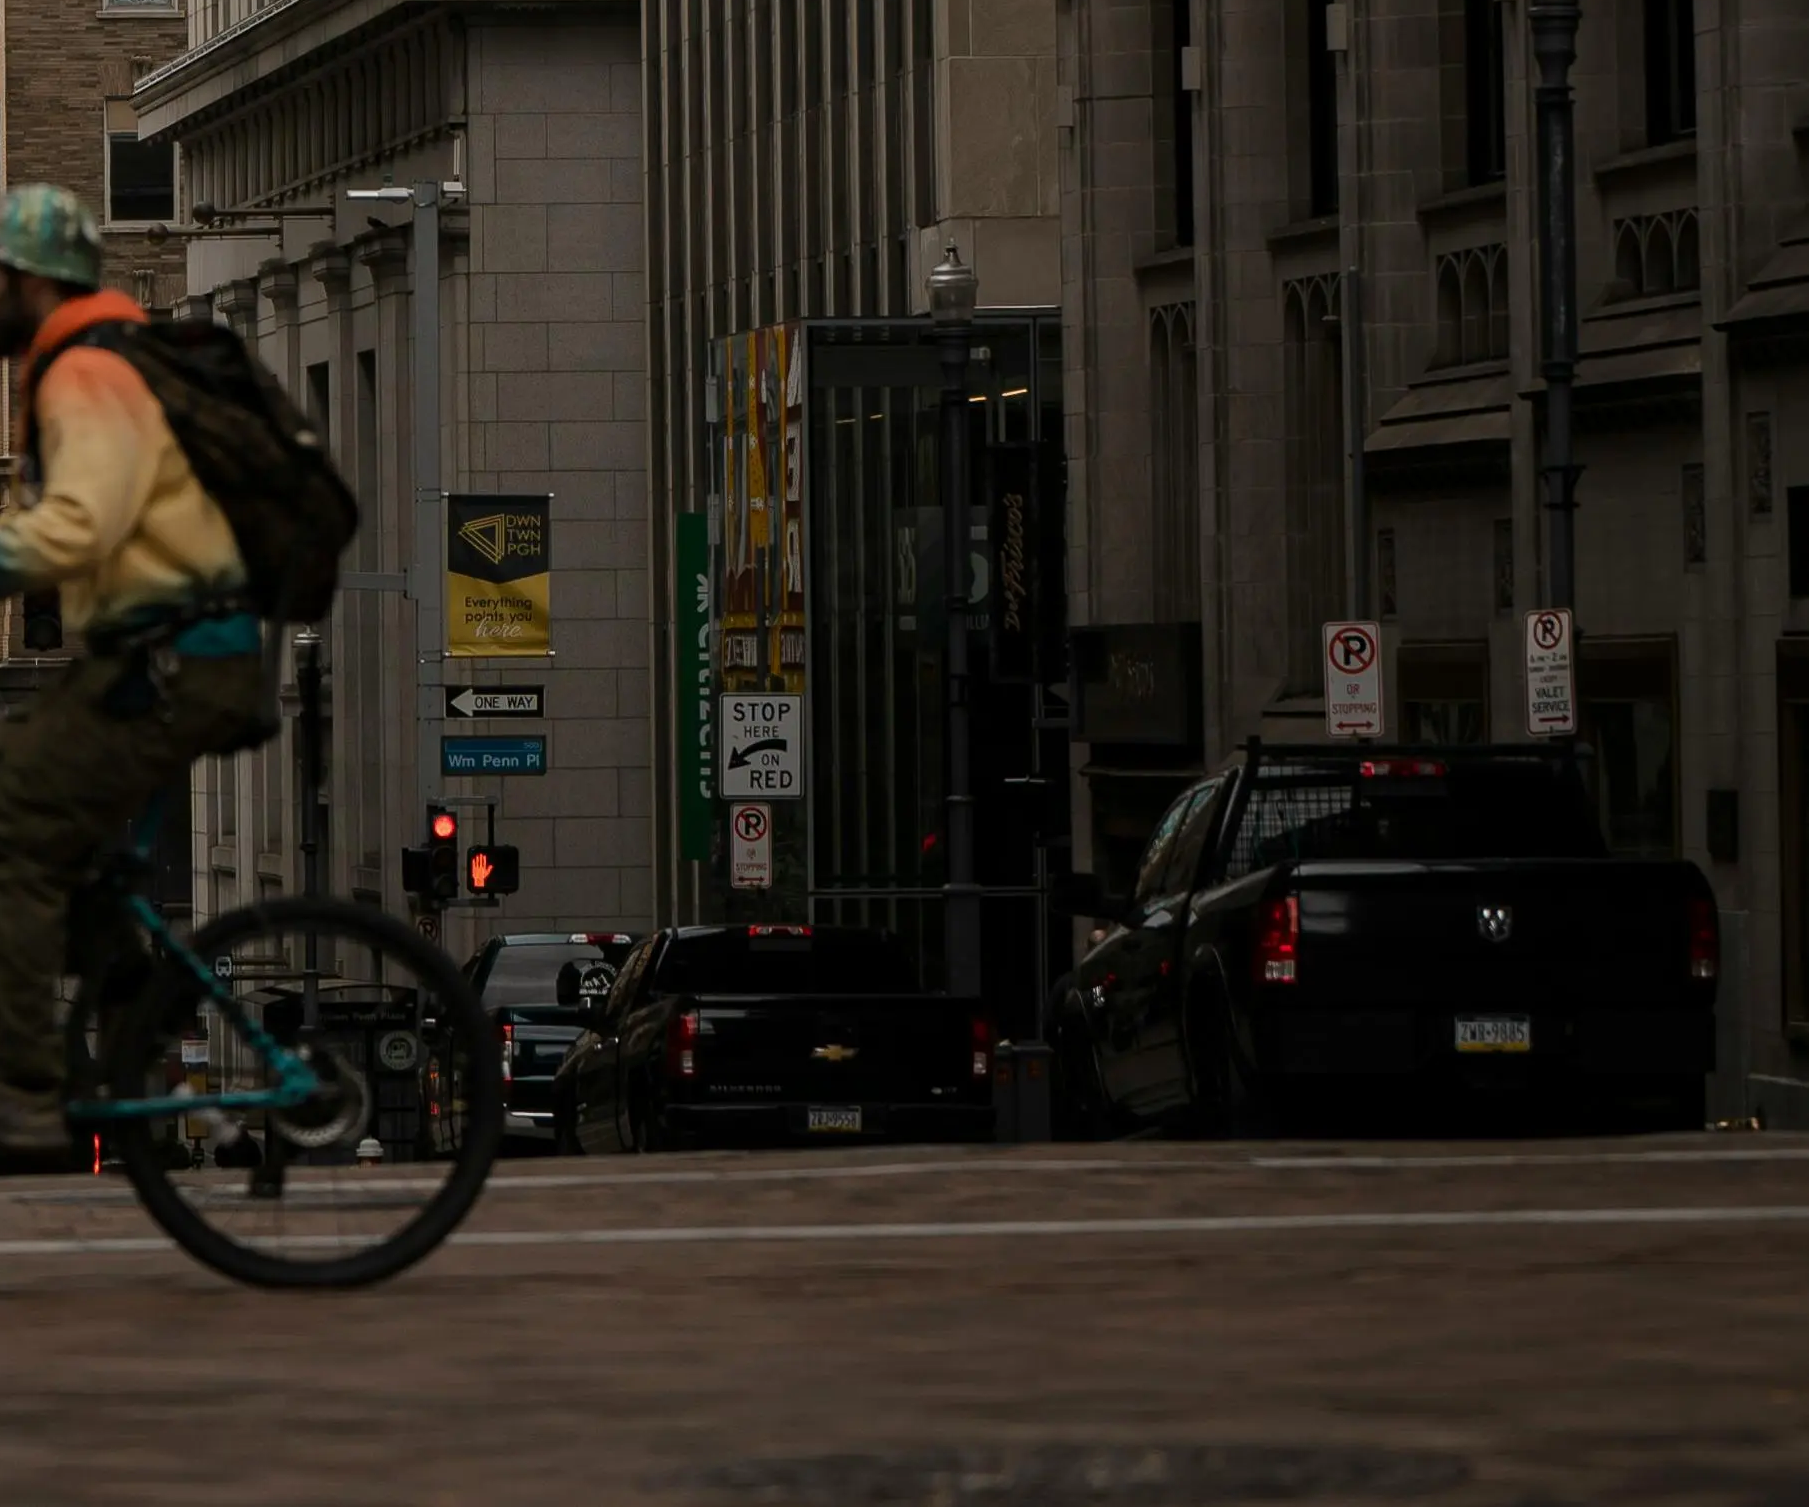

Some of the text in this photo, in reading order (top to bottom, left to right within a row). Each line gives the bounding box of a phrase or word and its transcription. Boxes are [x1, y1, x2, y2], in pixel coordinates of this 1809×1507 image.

[506, 514, 542, 528] DWN
[506, 529, 542, 542] TWN
[506, 543, 542, 556] PGH
[465, 597, 533, 611] Everything
[465, 611, 533, 624] points you
[1535, 686, 1565, 699] VALET
[475, 696, 533, 709] ONE WAY
[1331, 702, 1377, 716] STOPPING
[1532, 700, 1570, 714] SERVICE
[733, 702, 791, 722] STOP
[744, 725, 780, 738] HERE
[448, 753, 540, 767] Wm Penn Pl
[761, 754, 780, 766] ON
[749, 770, 793, 789] RED
